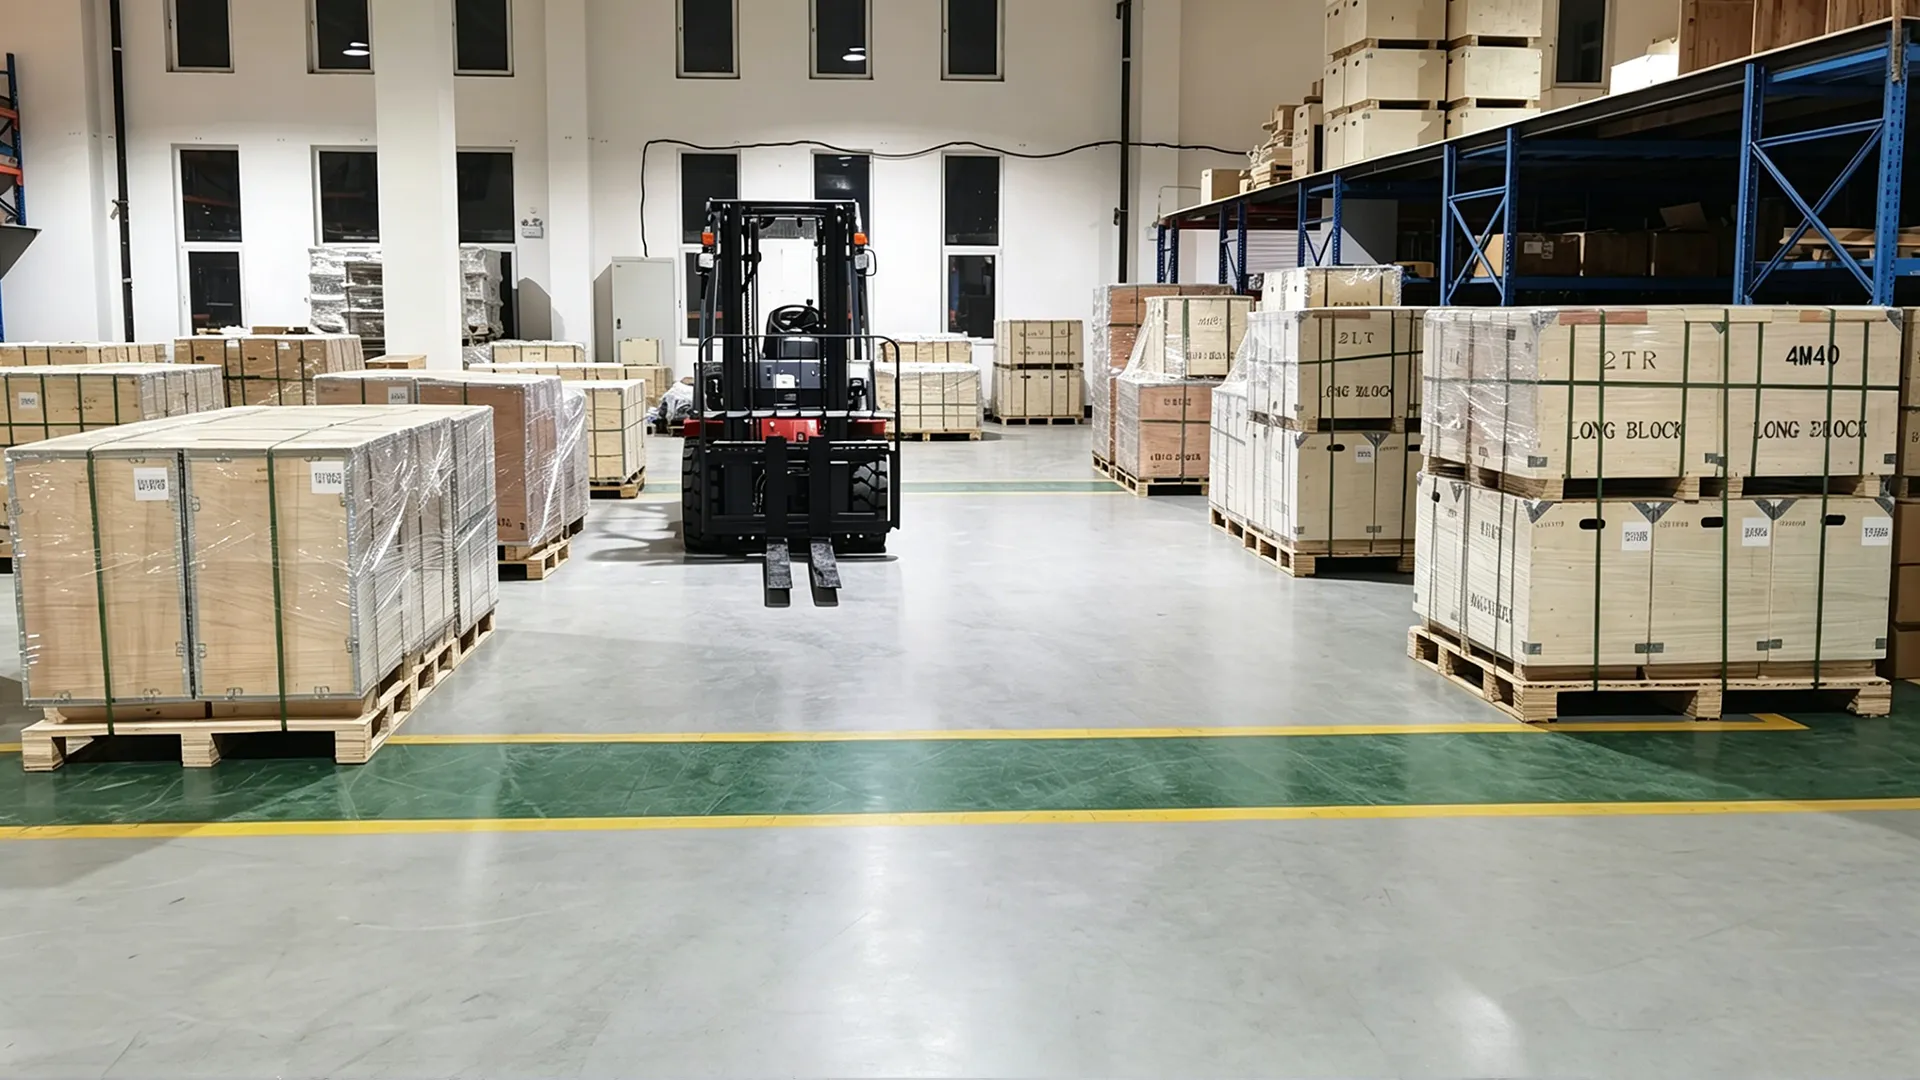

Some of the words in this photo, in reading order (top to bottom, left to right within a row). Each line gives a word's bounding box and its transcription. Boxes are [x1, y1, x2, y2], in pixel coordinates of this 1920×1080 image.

[1603, 350, 1657, 370] 2TR
[1785, 344, 1840, 366] 4M40
[1321, 385, 1350, 398] ONG
[1626, 421, 1683, 440] BLOCK
